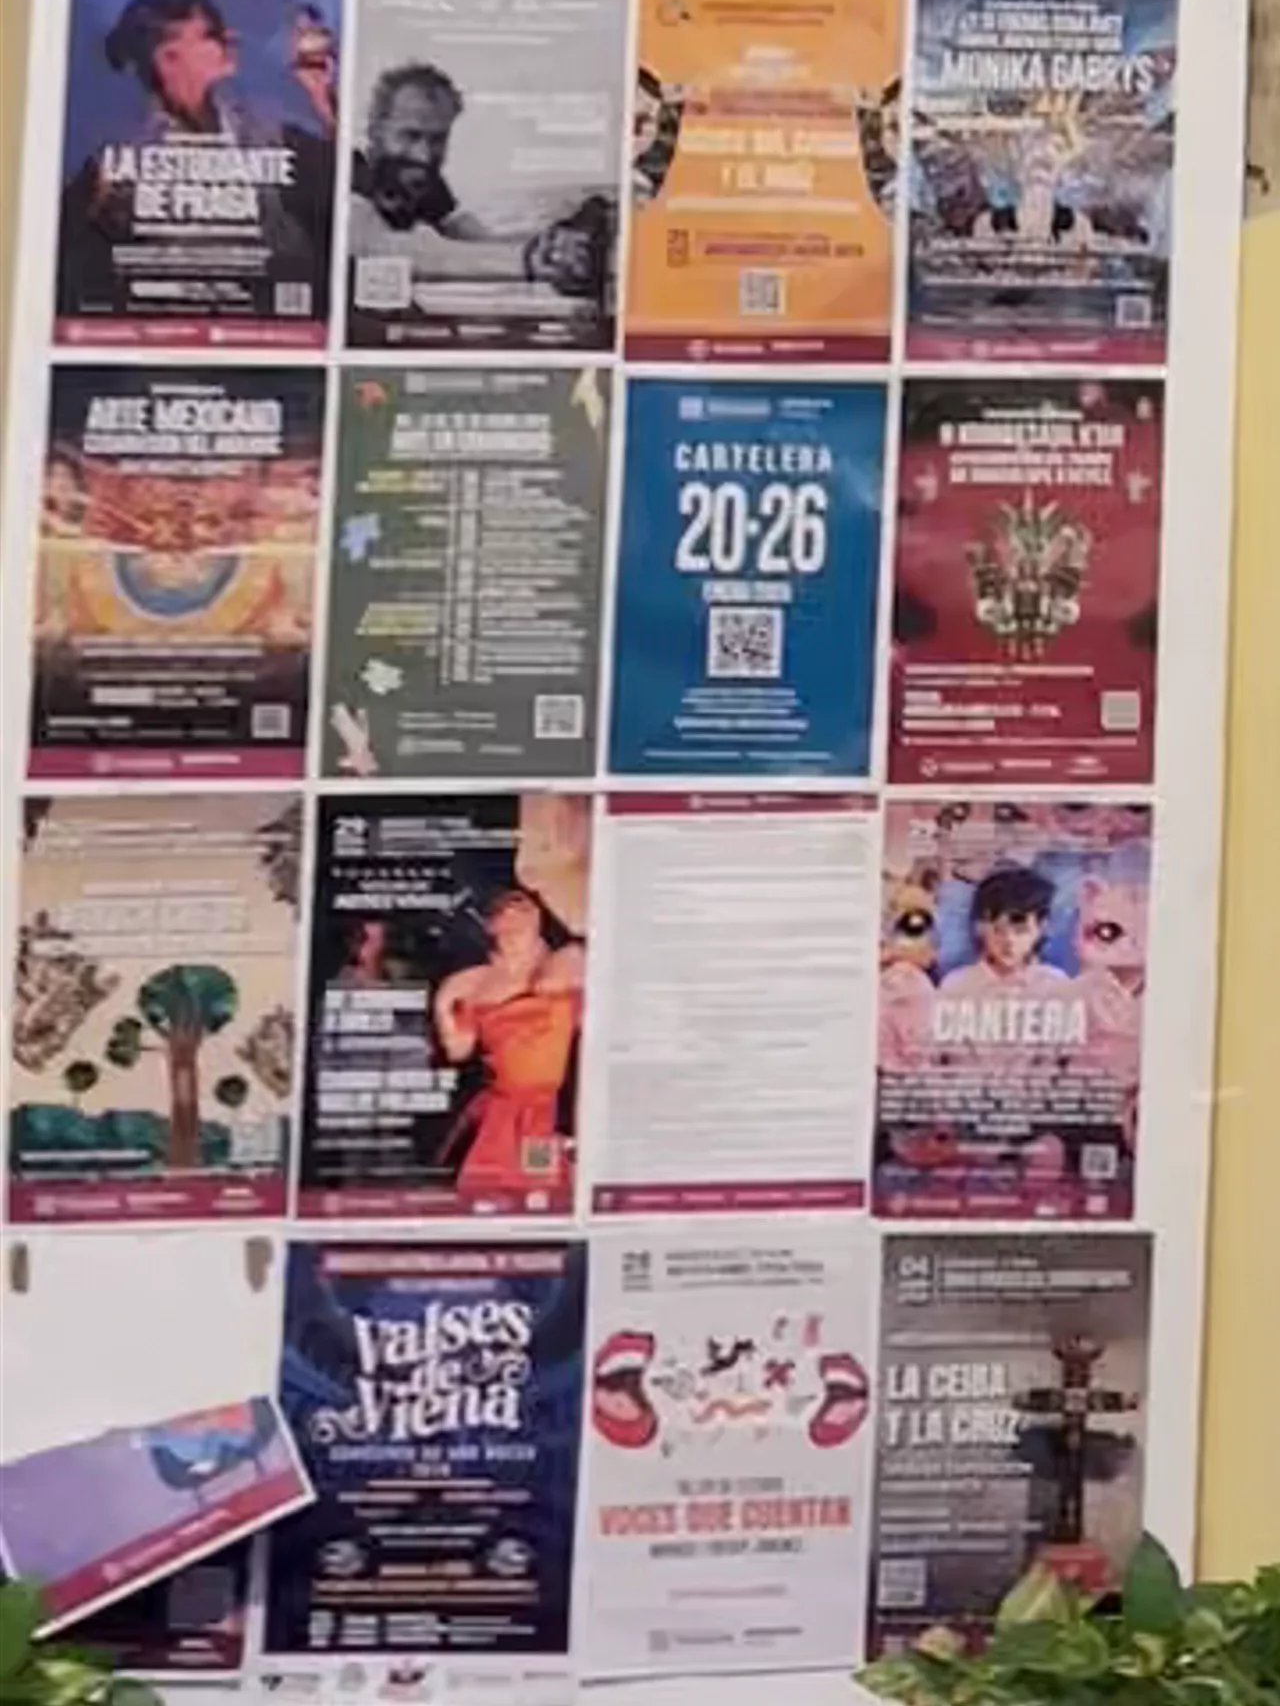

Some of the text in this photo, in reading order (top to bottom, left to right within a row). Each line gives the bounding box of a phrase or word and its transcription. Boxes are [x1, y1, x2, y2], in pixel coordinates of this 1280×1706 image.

[104, 146, 137, 181] LA
[674, 442, 833, 474] CARTELERA
[933, 998, 1088, 1045] CANTERA
[353, 1298, 532, 1377] Valses
[887, 1364, 919, 1401] LA
[355, 1374, 521, 1442] Viena
[911, 1409, 944, 1446] LA
[950, 1409, 1021, 1448] CRUZ
[599, 1496, 851, 1537] VOCES QUE CUENTAN
